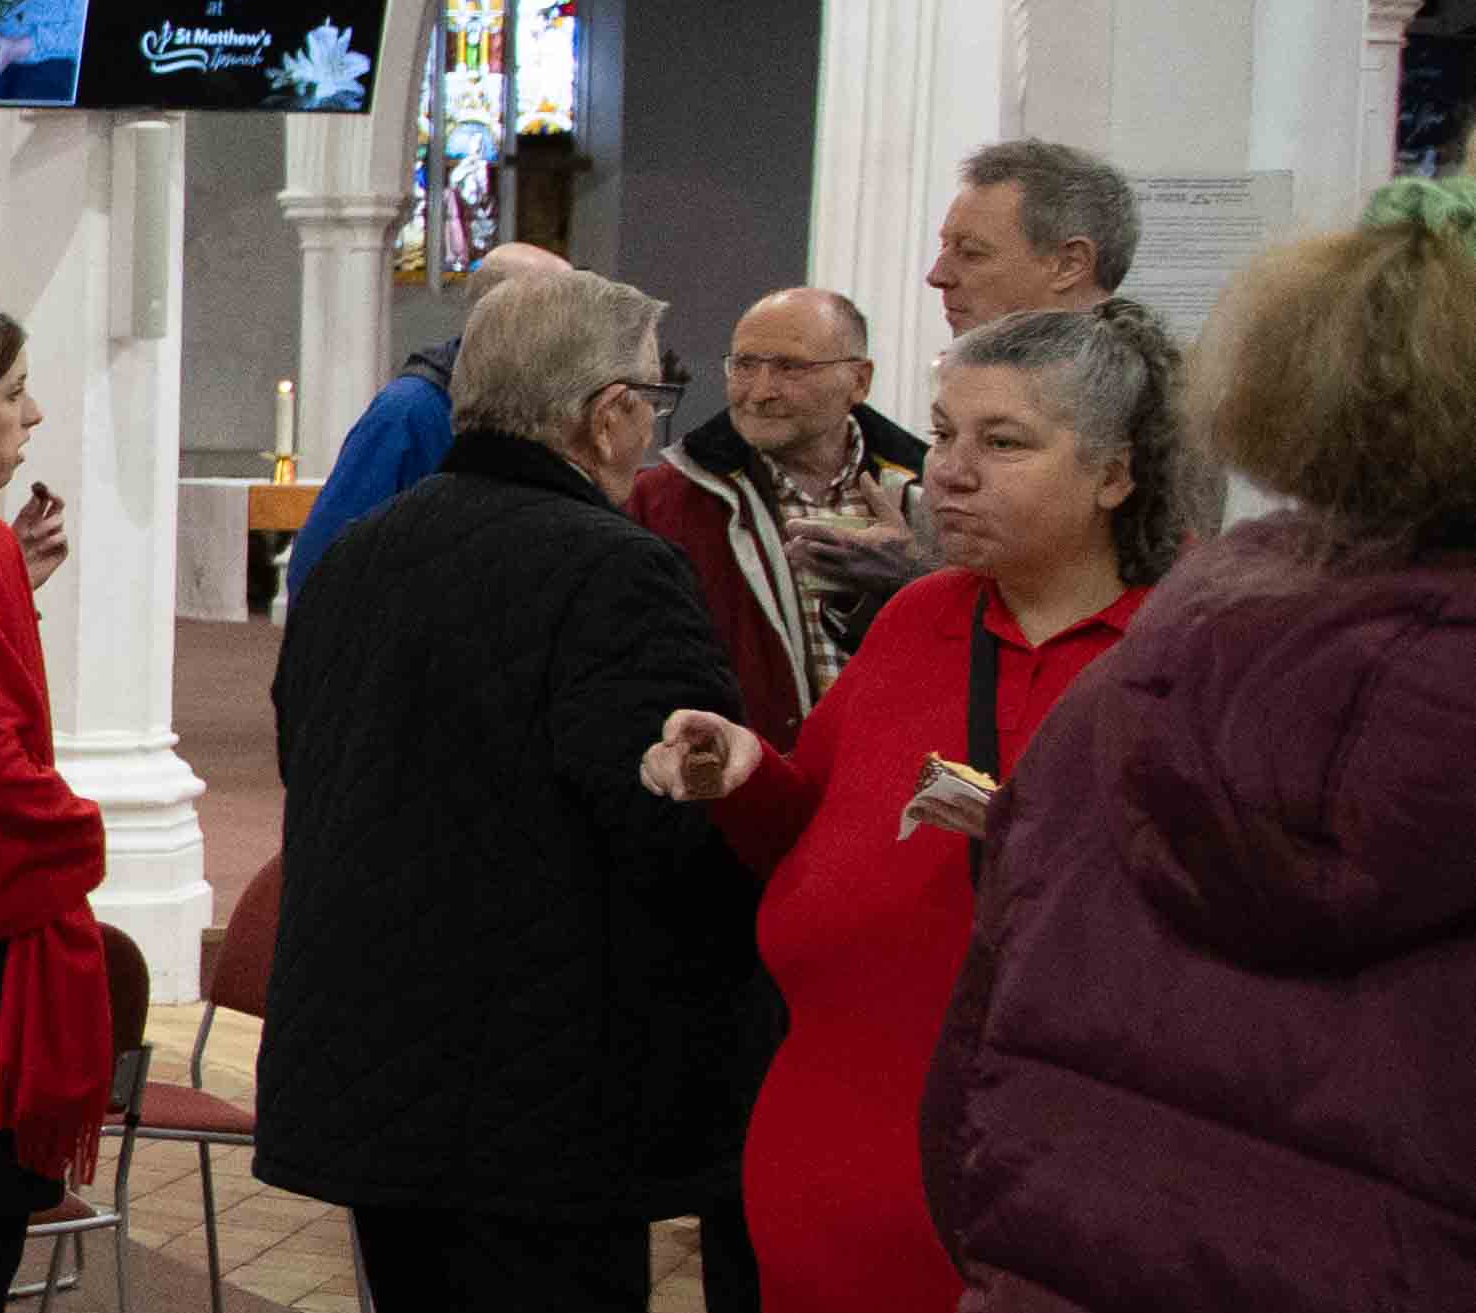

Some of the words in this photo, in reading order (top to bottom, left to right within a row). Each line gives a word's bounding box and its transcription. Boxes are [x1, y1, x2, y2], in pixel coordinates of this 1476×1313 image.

[206, 0, 226, 16] at
[174, 28, 192, 46] St
[194, 28, 272, 47] Matthew's
